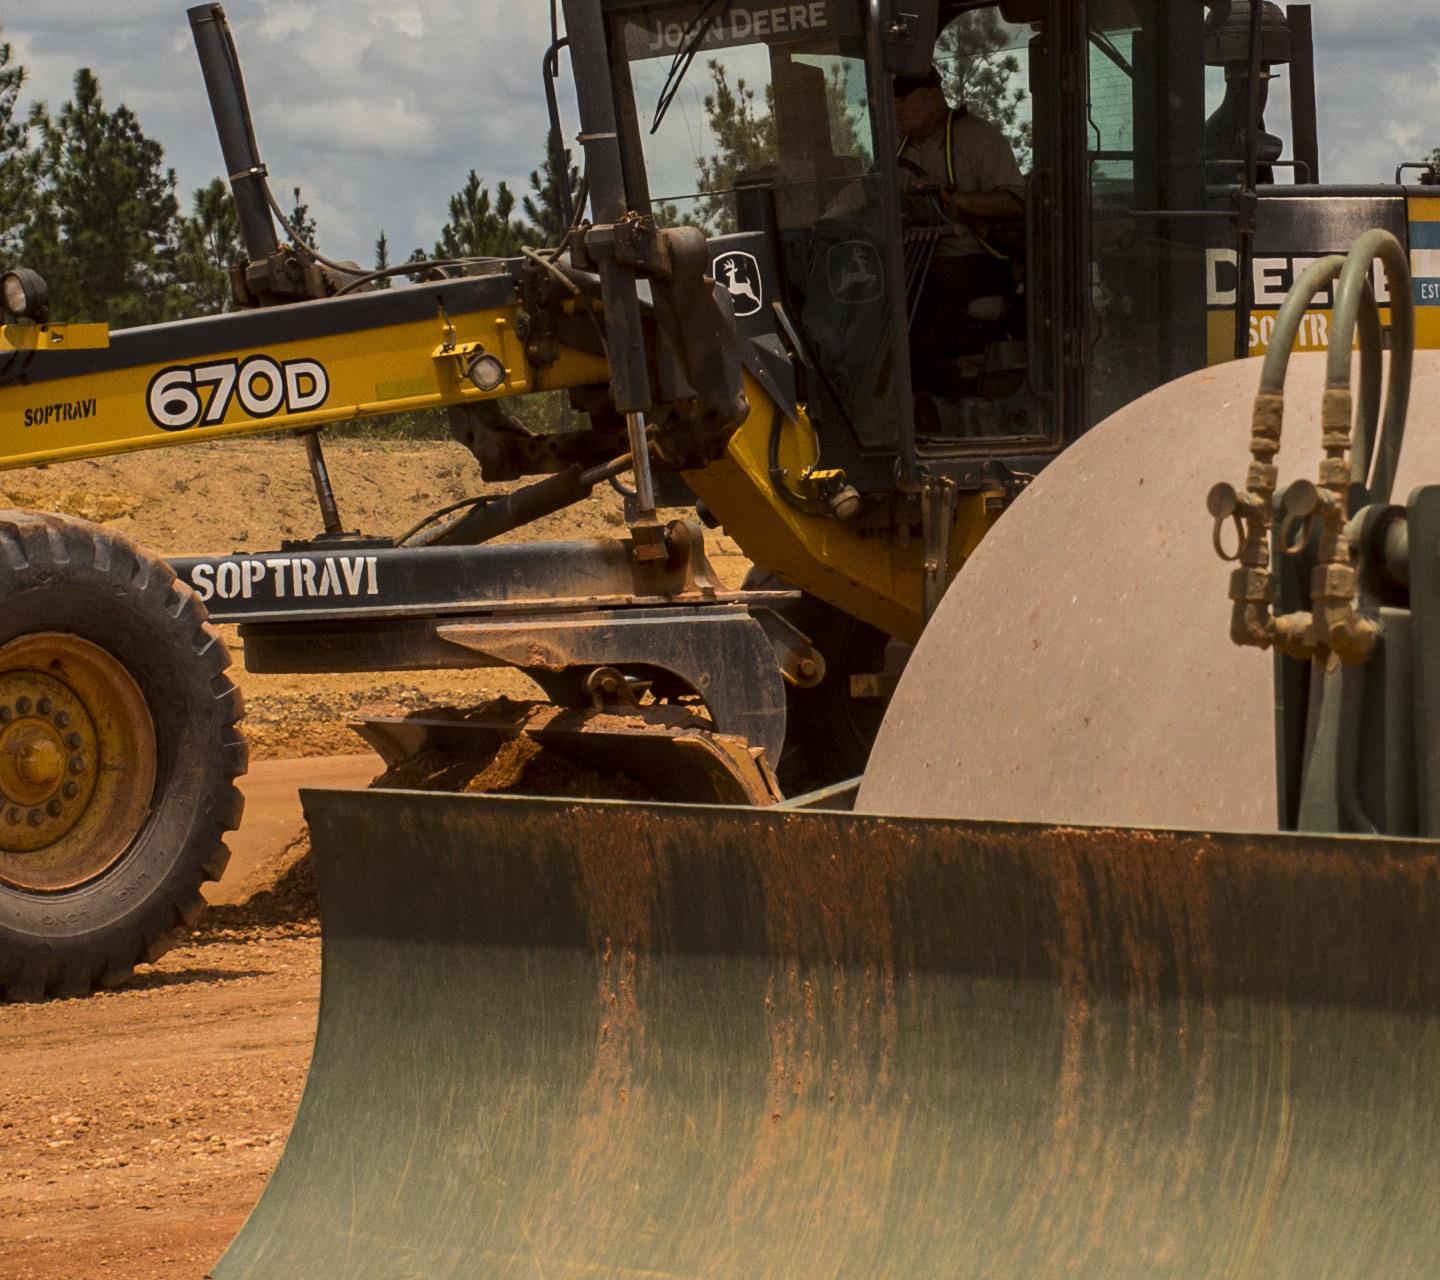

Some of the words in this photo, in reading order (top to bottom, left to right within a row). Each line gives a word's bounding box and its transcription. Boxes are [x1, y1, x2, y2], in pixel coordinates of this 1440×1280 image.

[730, 1, 828, 39] DEERE
[23, 398, 97, 427] SOPTRAVI
[147, 355, 328, 430] 670D
[191, 556, 379, 602] SOPTRAVI
